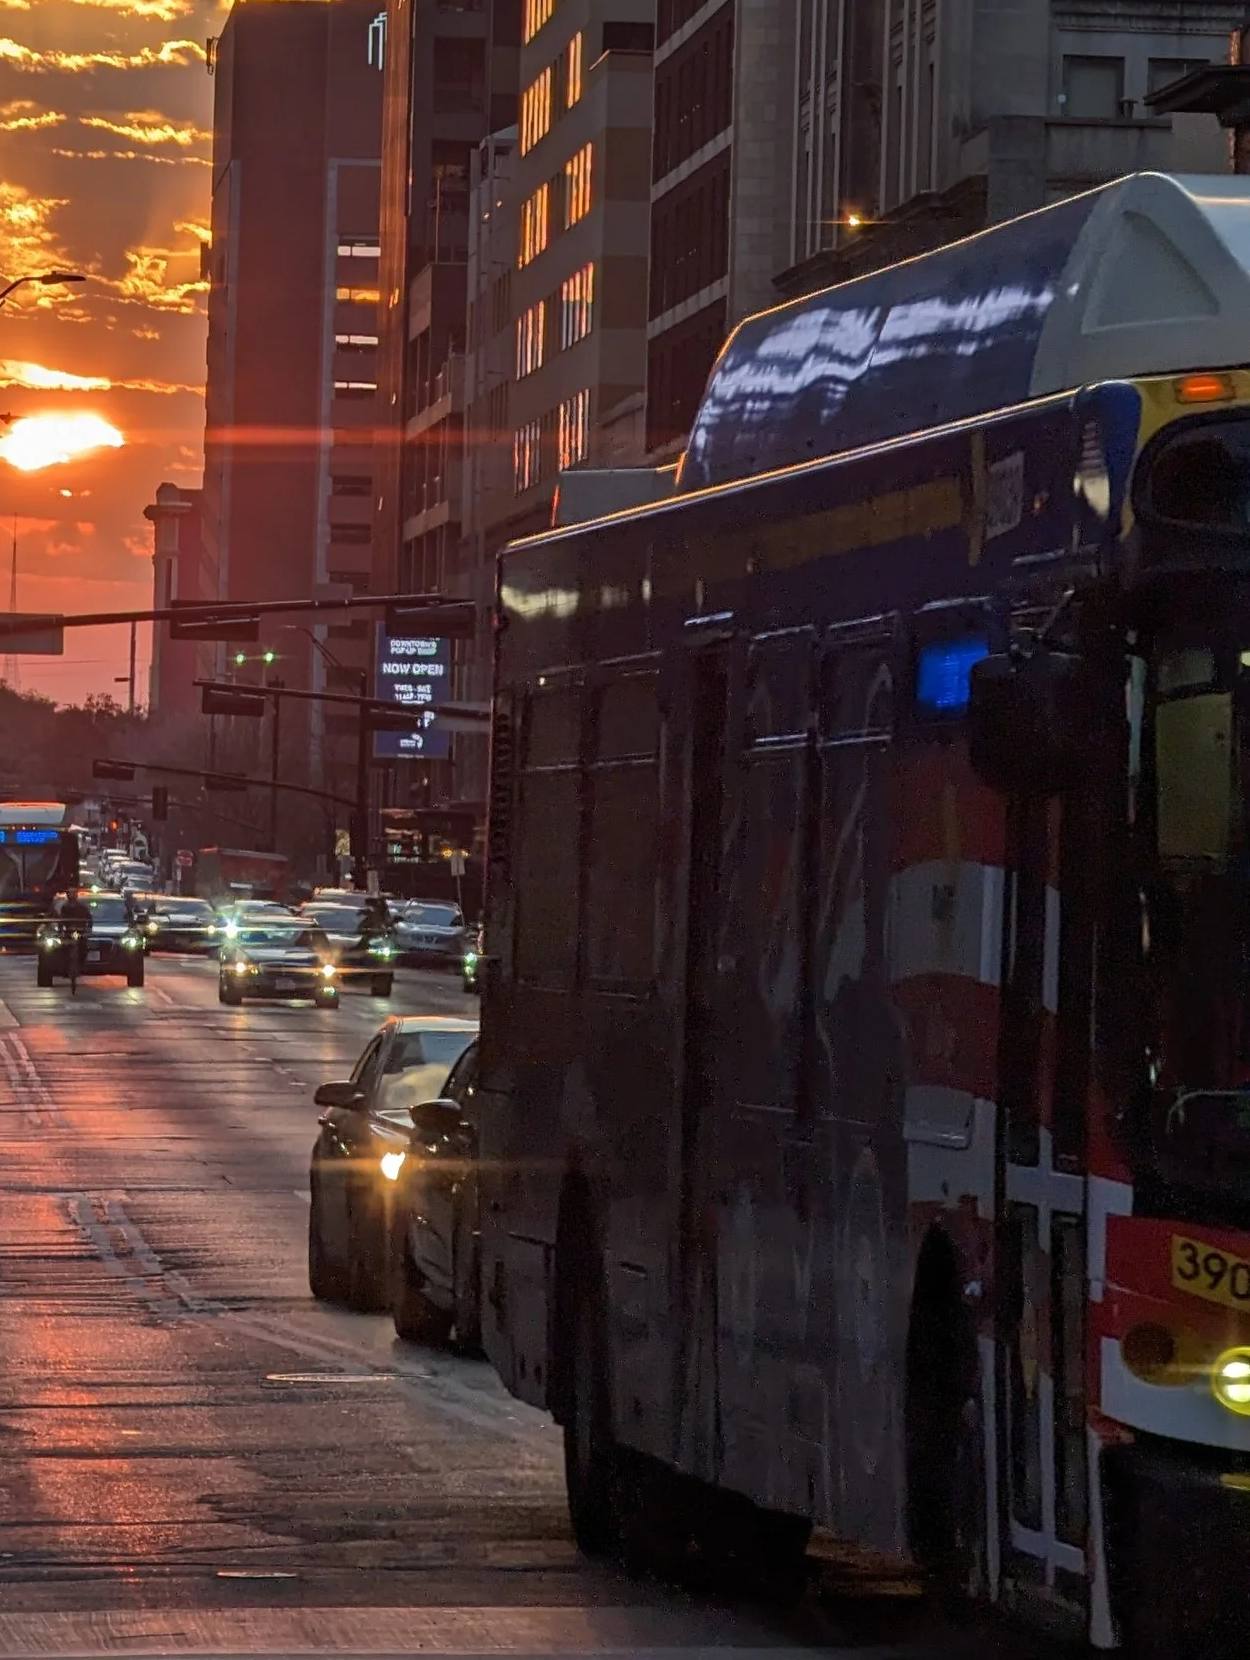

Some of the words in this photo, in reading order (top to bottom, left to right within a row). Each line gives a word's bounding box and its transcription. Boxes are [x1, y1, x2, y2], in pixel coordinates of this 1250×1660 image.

[382, 662, 410, 674] NOW
[412, 663, 443, 676] OPEN
[1177, 1242, 1250, 1302] 390
